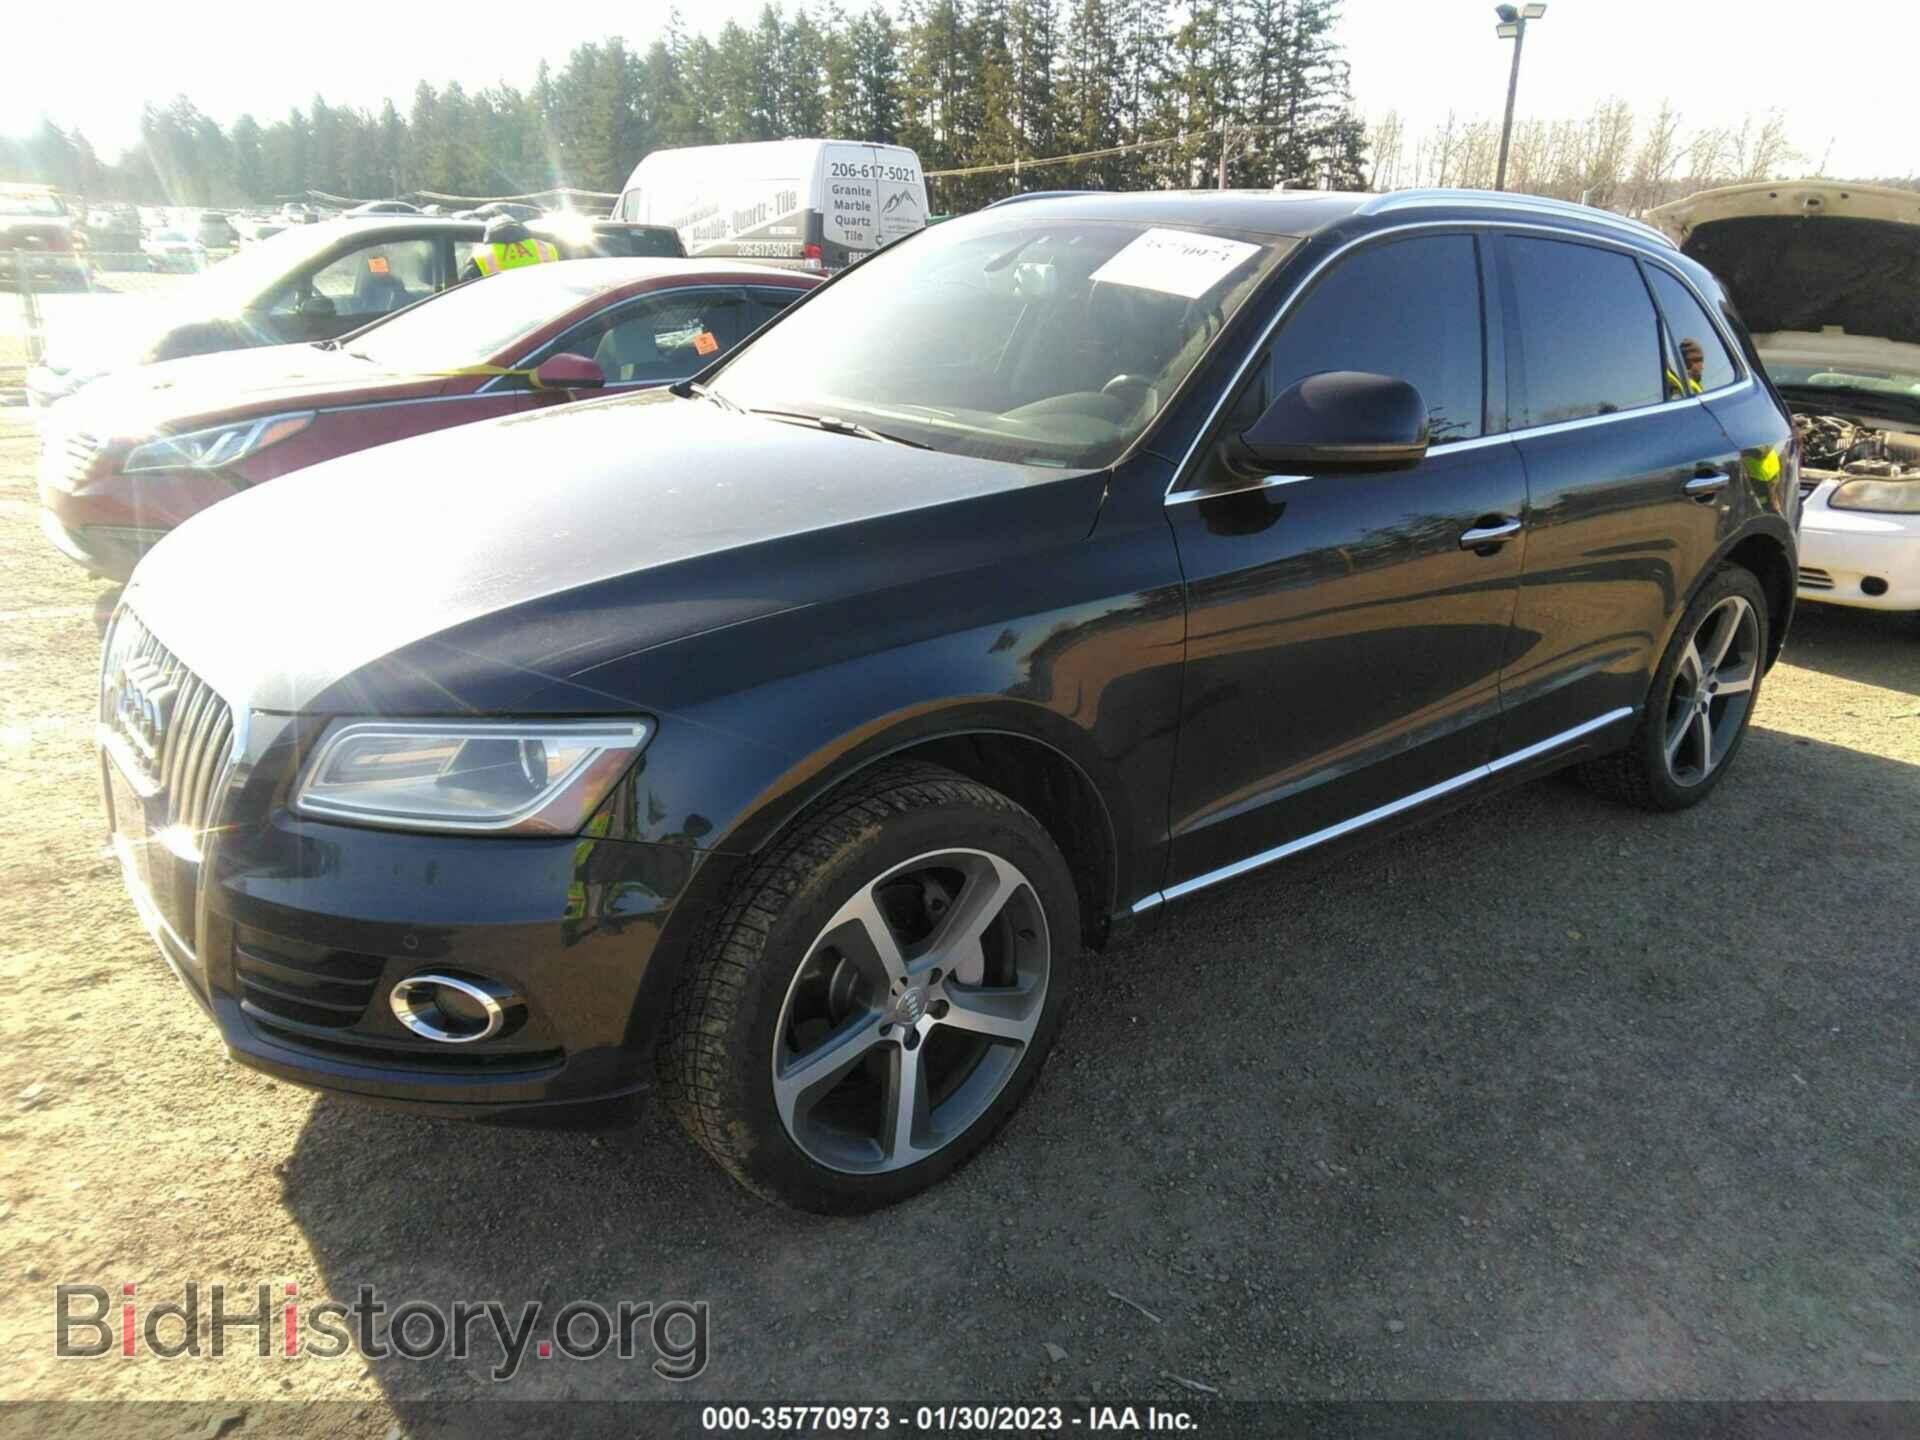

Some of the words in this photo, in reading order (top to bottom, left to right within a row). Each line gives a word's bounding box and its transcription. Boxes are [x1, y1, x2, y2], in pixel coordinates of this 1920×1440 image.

[831, 163, 915, 182] 206-617-5021
[832, 184, 872, 197] Granite
[774, 189, 797, 216] Tile
[834, 200, 871, 211] Marble
[835, 215, 871, 227] Quartz
[844, 230, 863, 240] Tile
